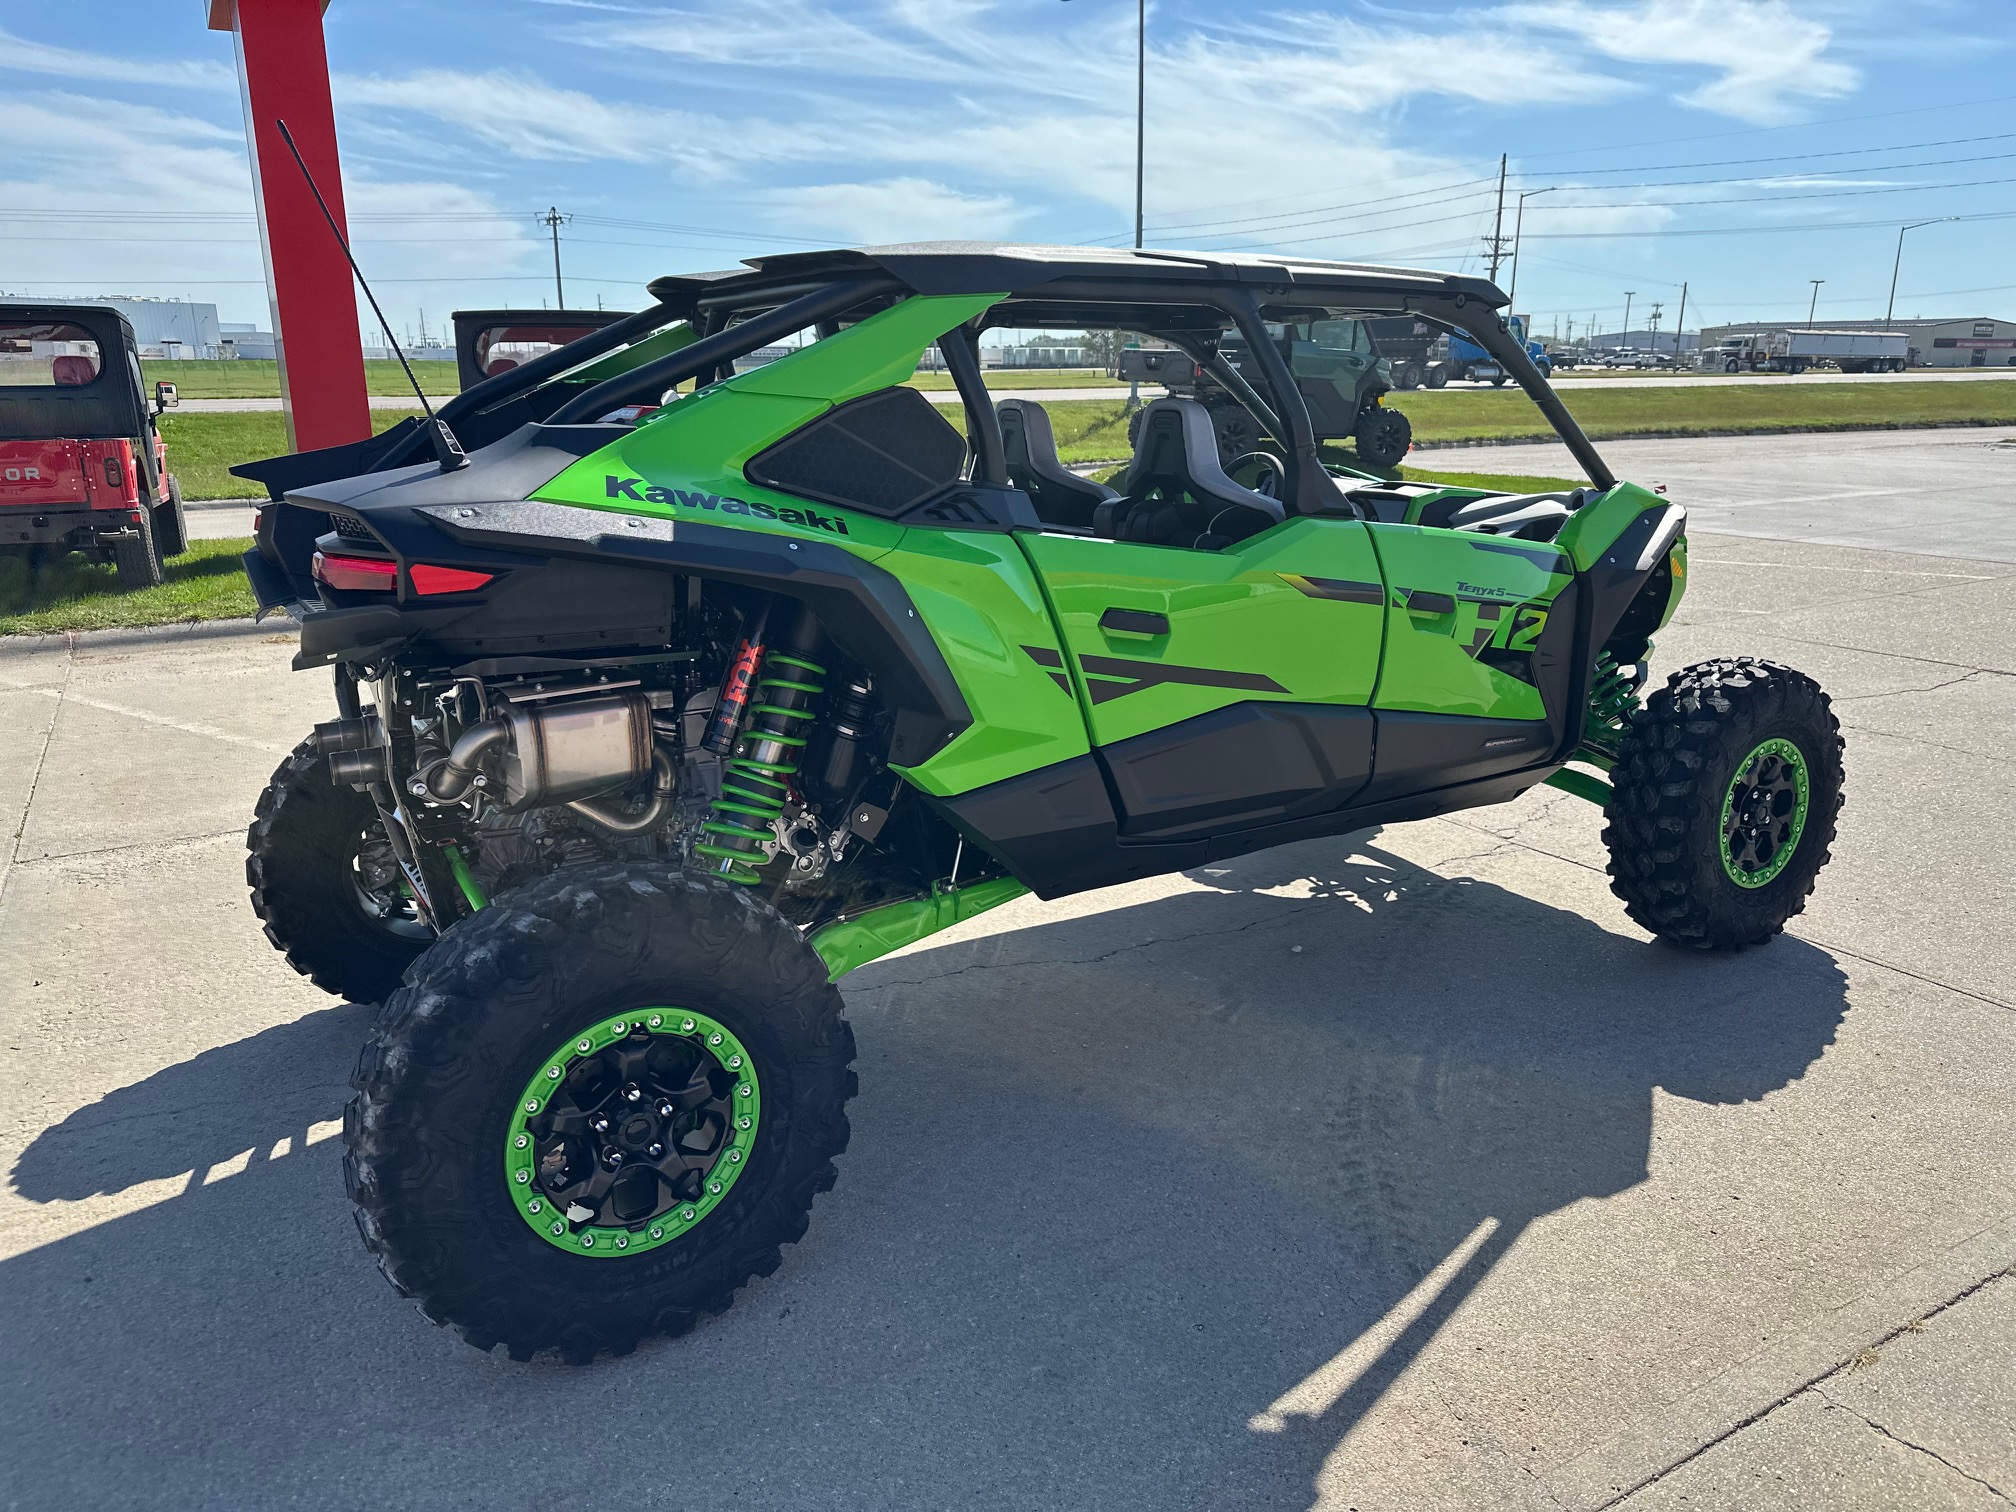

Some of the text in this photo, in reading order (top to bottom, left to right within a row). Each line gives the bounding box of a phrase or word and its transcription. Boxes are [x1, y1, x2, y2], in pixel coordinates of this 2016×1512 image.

[0, 467, 41, 481] OR
[605, 475, 850, 536] Kawasaki
[1454, 601, 1549, 652] H2
[723, 638, 766, 706] FOX
